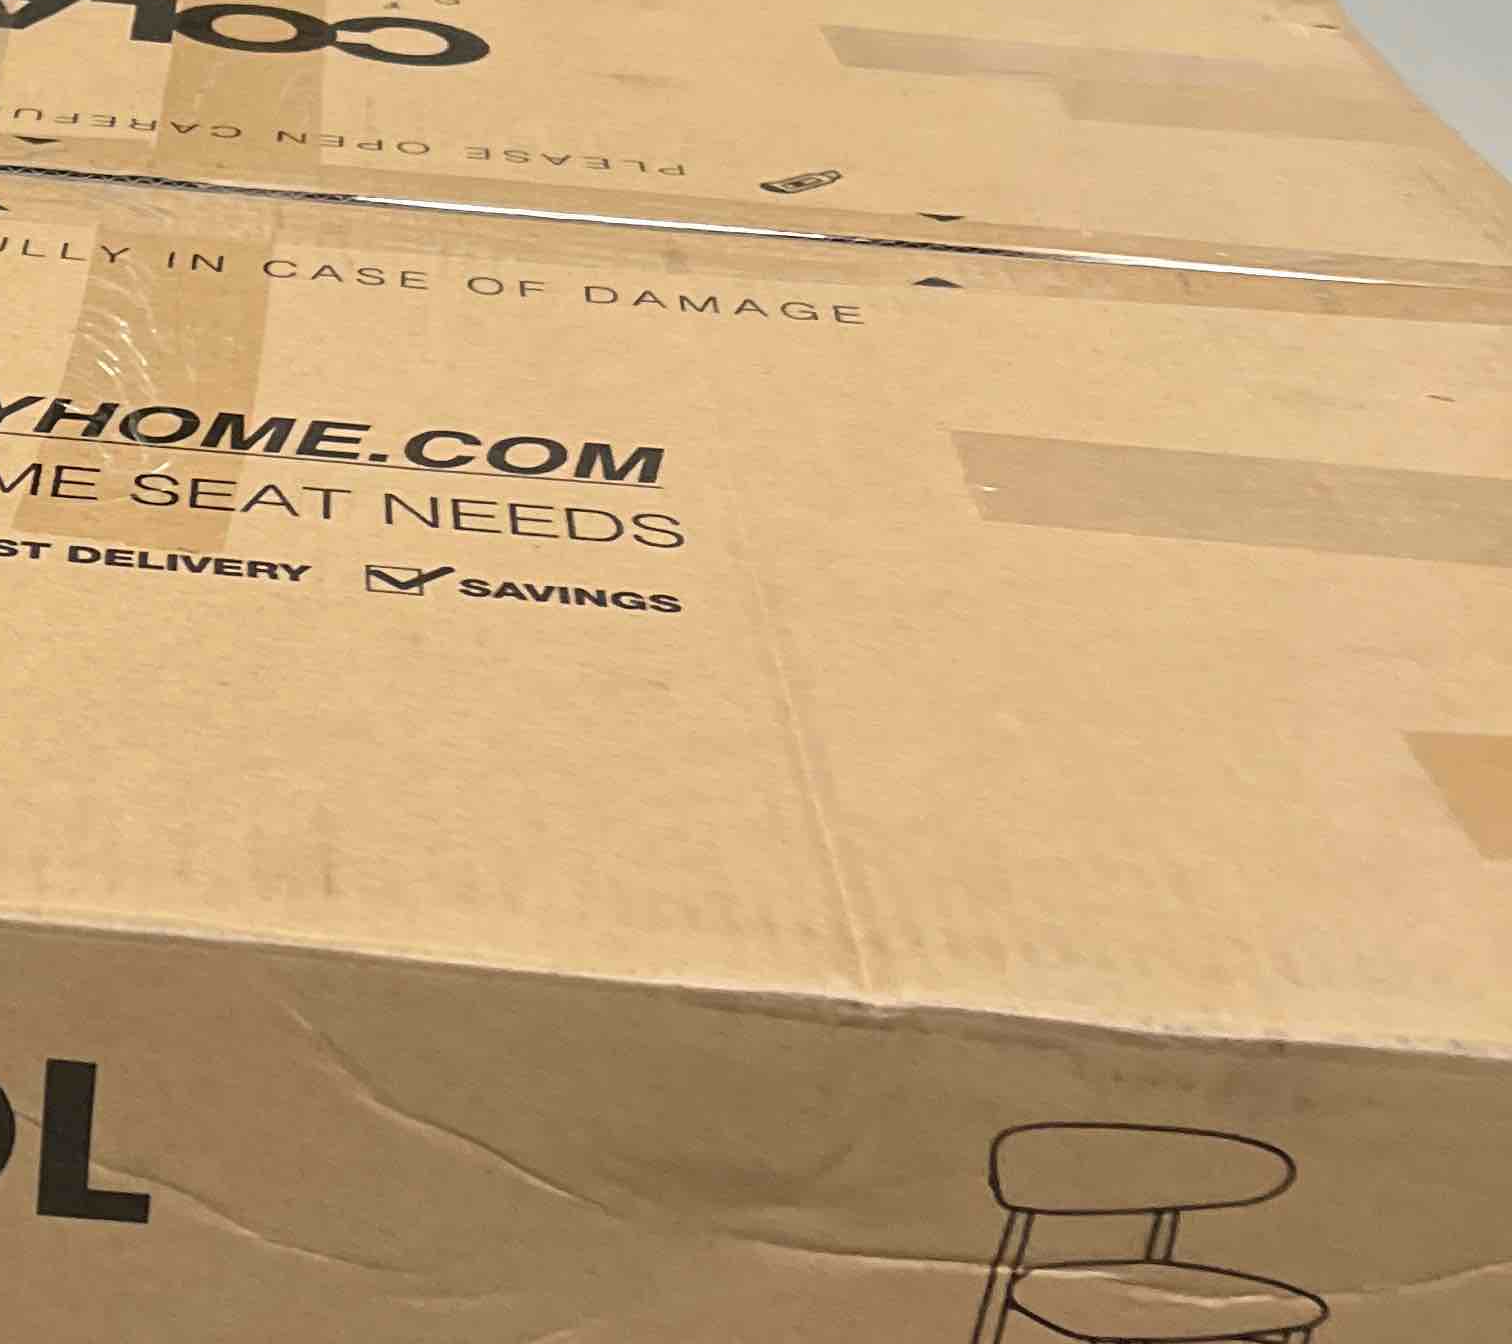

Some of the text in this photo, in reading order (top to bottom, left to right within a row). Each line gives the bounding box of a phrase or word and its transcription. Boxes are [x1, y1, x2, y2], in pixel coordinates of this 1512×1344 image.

[277, 131, 429, 153] OPEN
[468, 147, 684, 175] PLEASE
[168, 252, 223, 272] IN
[263, 261, 427, 289] CASE
[468, 277, 544, 296] OF
[584, 286, 864, 324] DAMAGE
[130, 474, 351, 519] SEAT
[384, 494, 683, 548] NEEDS
[68, 546, 311, 581] DELIVERY
[460, 579, 681, 612] SAVINGS
